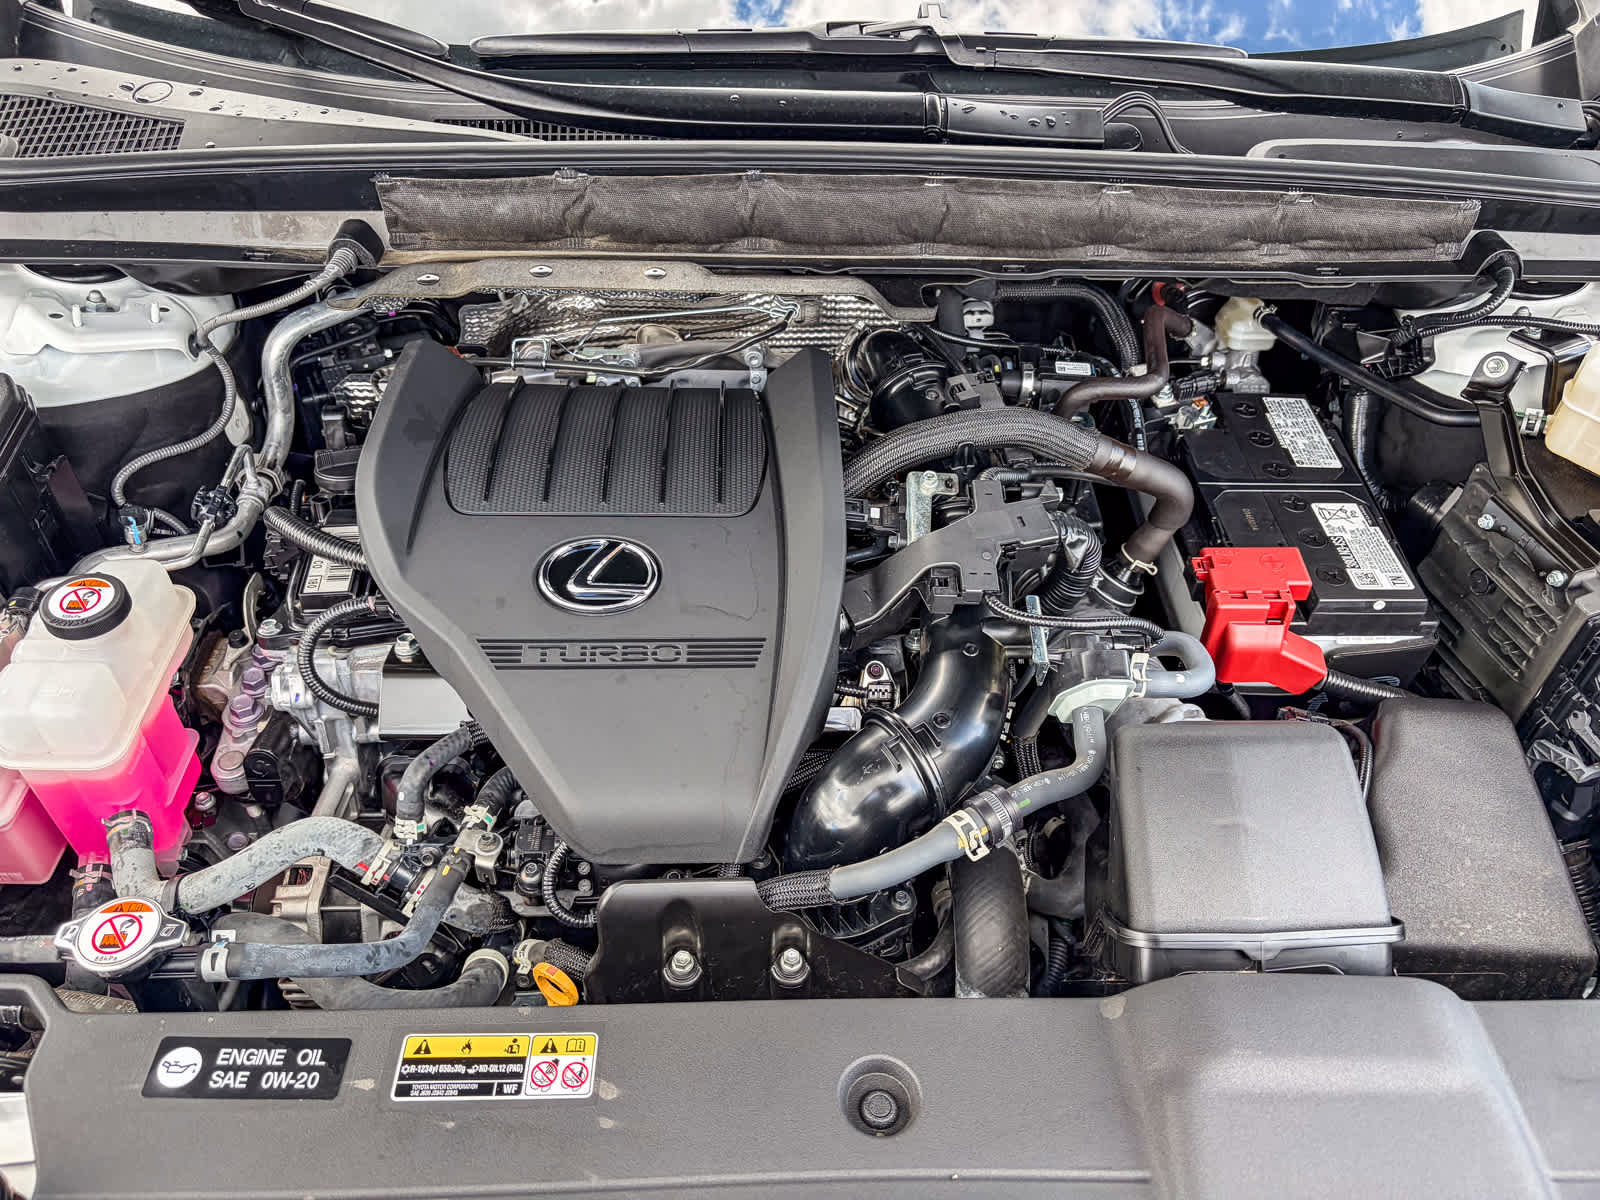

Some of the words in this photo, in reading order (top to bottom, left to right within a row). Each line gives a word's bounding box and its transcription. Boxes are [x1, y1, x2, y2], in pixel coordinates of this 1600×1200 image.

[527, 643, 683, 663] TURBO
[216, 1048, 287, 1065] ENGINE
[296, 1048, 326, 1066] OIL
[208, 1070, 250, 1088] SAE
[260, 1071, 320, 1089] 0W-20
[503, 1084, 518, 1094] WF
